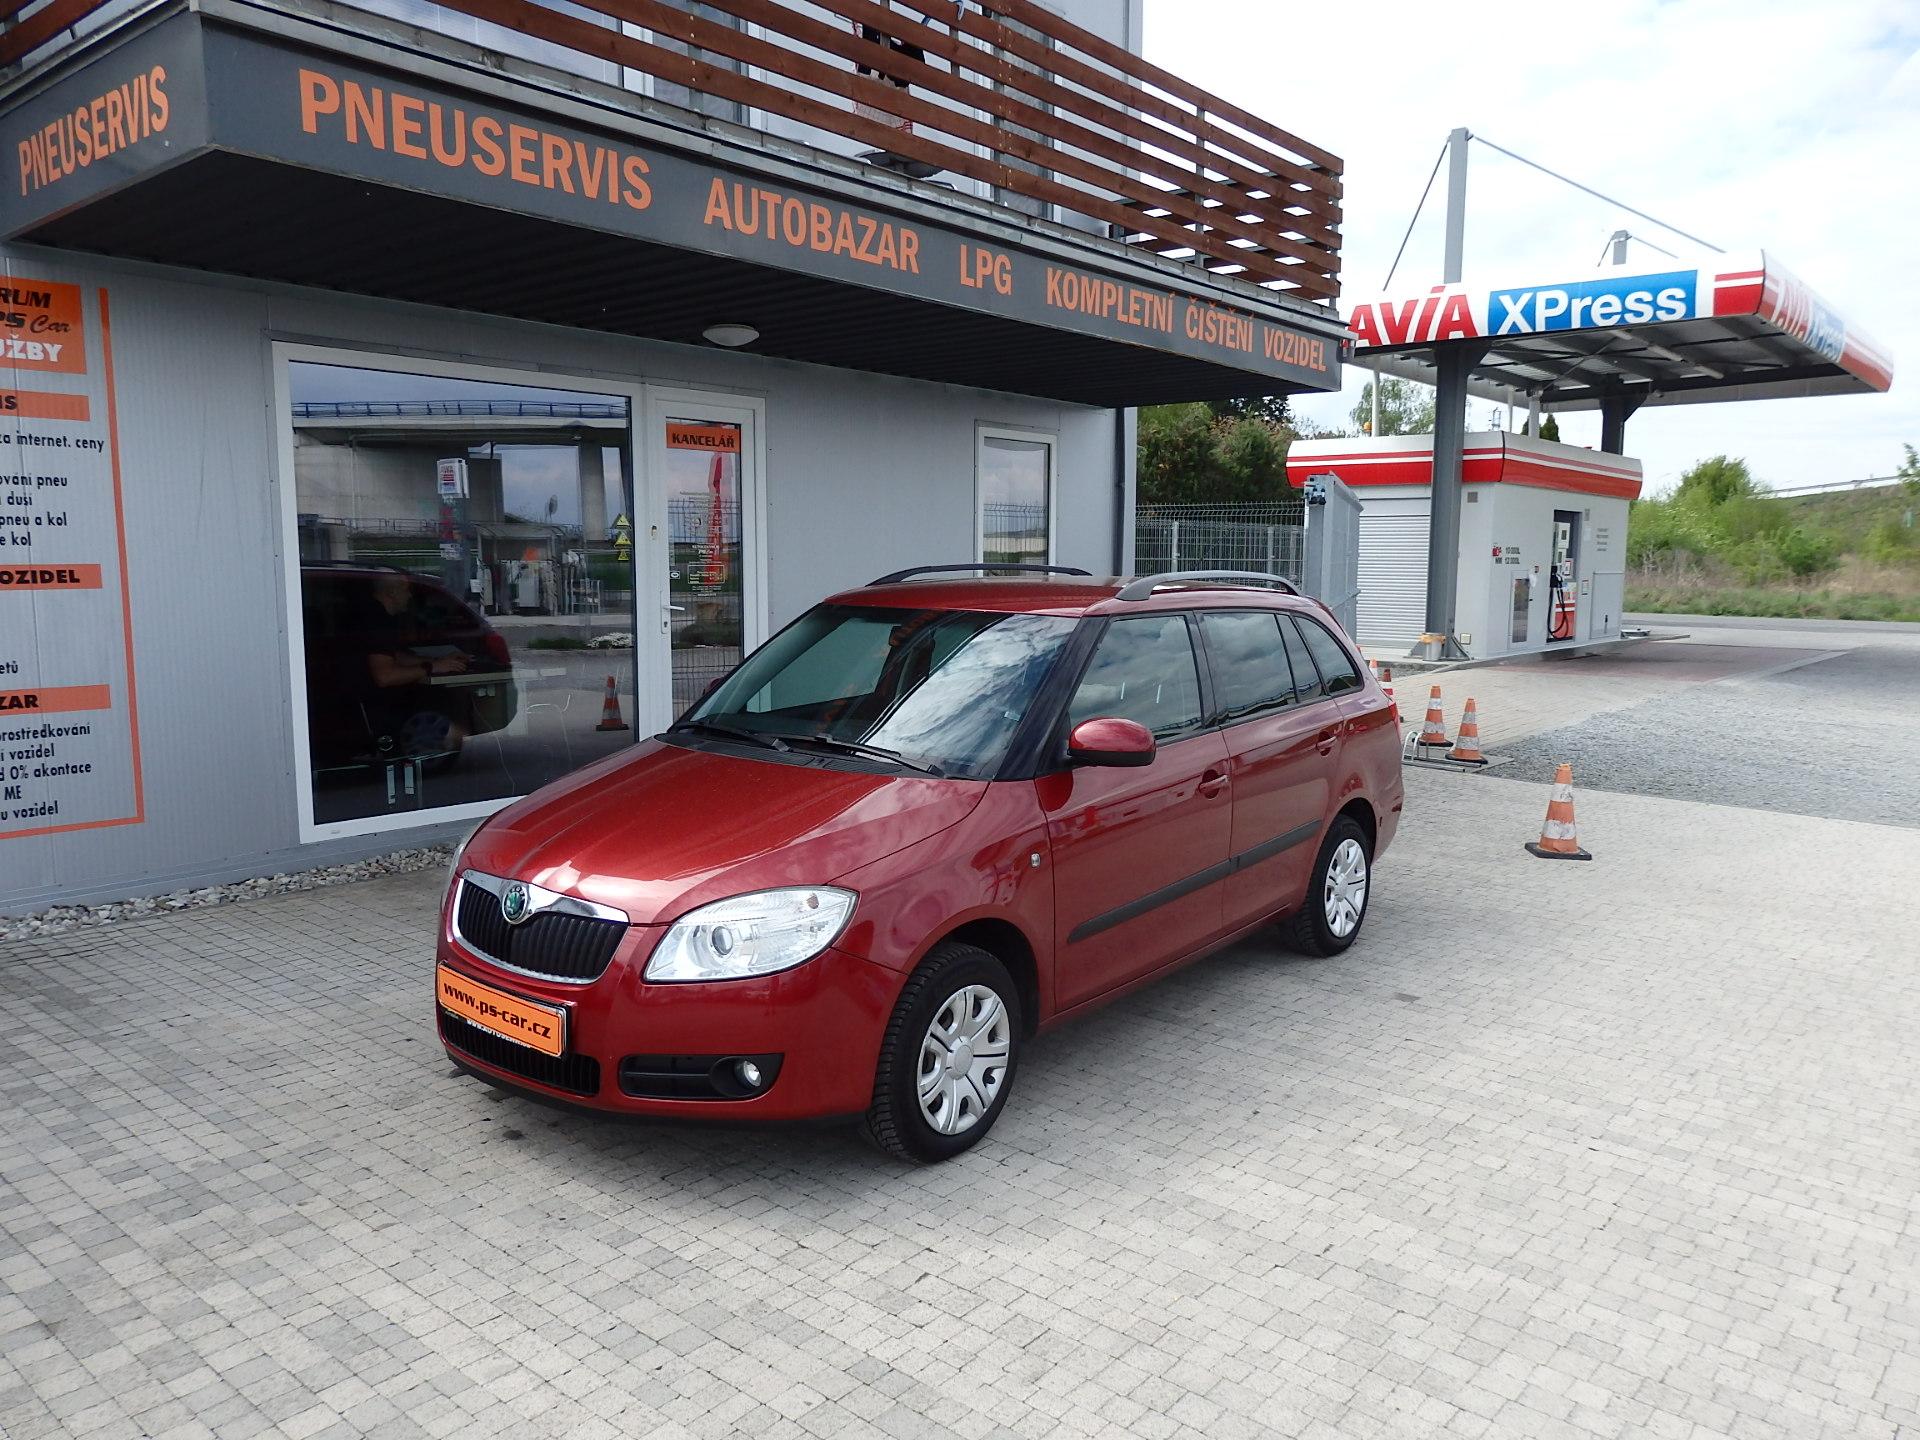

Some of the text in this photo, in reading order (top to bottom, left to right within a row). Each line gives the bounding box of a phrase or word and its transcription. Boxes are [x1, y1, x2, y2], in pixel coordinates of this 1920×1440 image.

[18, 65, 169, 196] PNEUSERVIS
[299, 68, 1327, 372] PNEUSERVIS AUTOBAZAR LPG KOMPLETNÍ ČIŠTĚNÍ VOZIDEL
[1500, 287, 1688, 335] XPress
[30, 314, 71, 333] Car
[16, 430, 71, 448] internet.
[75, 438, 104, 453] ceny
[672, 432, 734, 448] KANCELÁŘ
[37, 475, 68, 489] pneu
[35, 516, 42, 526] a
[47, 511, 67, 527] kol
[11, 531, 32, 547] kol
[9, 742, 55, 761] vozidel
[10, 764, 29, 780] 0%
[33, 762, 92, 778] akontace
[13, 800, 59, 819] vozidel
[444, 983, 551, 1039] www.ps-car.cz
